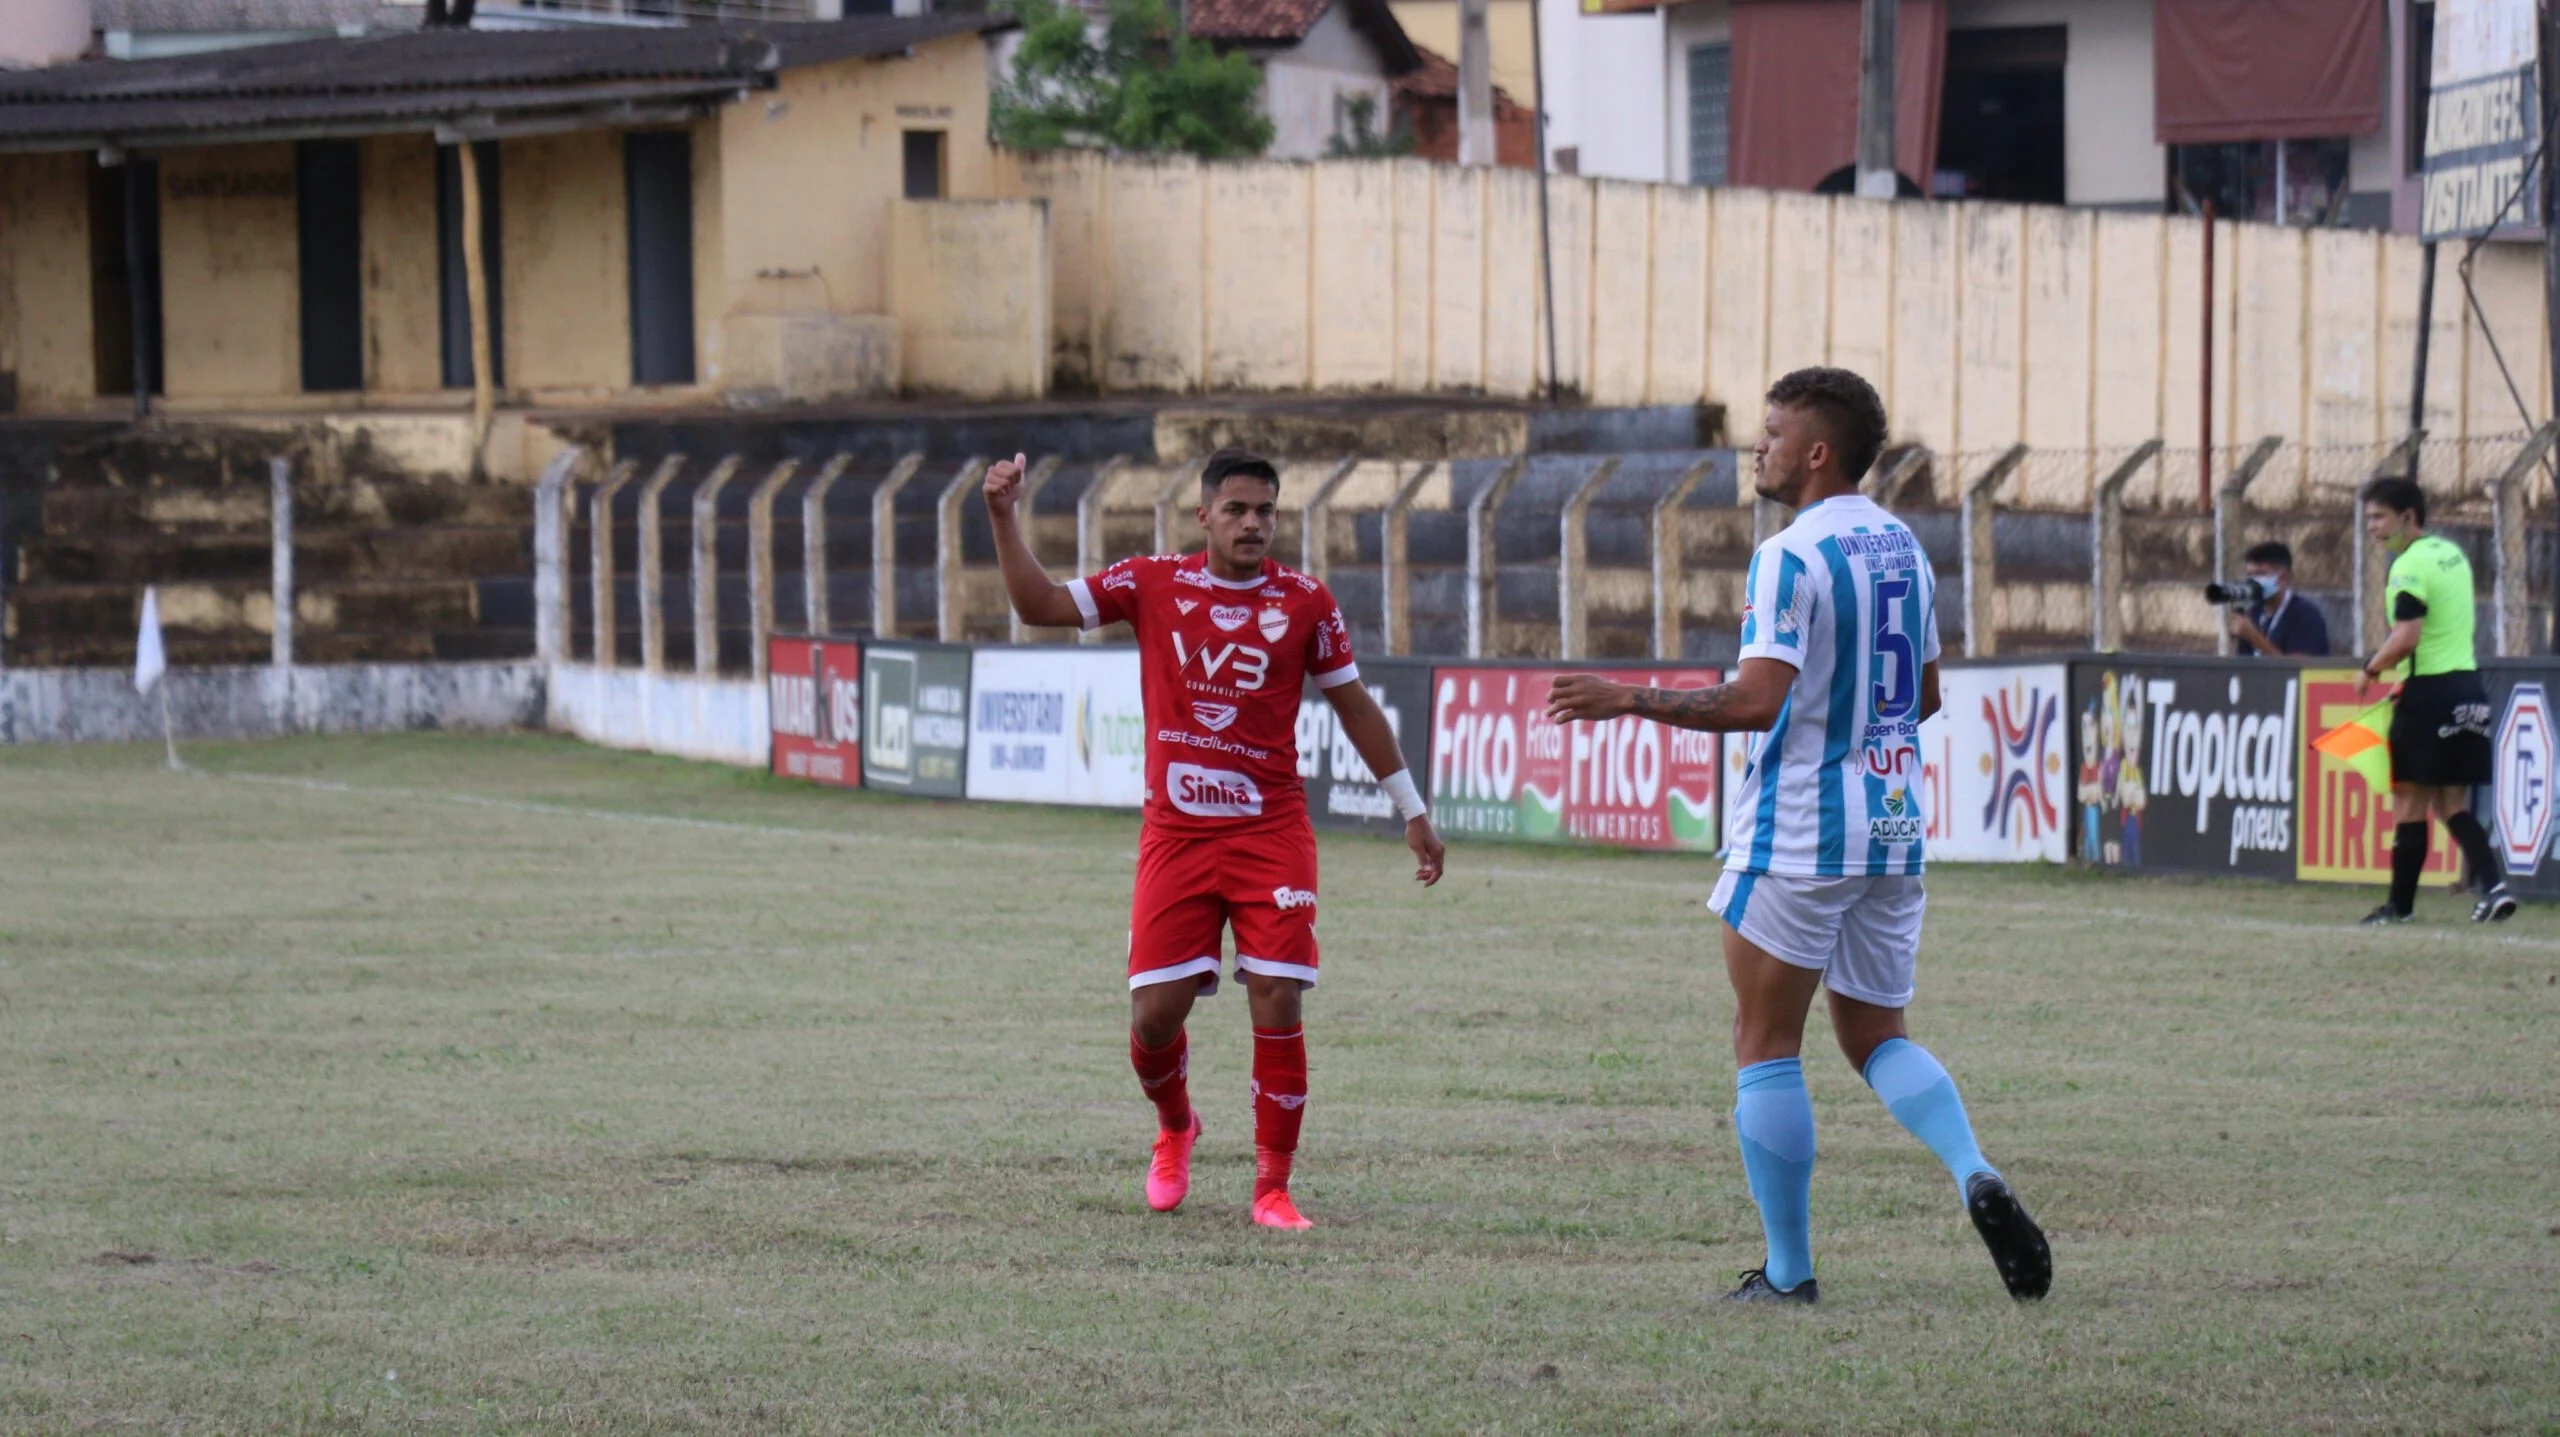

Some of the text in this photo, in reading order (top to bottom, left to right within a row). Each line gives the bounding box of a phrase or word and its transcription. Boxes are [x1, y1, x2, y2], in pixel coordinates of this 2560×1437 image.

[1211, 606, 1248, 623] Garlic
[1873, 578, 1915, 719] 5
[1186, 679, 1241, 698] COMPANIES
[1896, 721, 1919, 736] Bo
[1157, 729, 1269, 760] estadium.bet
[2147, 675, 2298, 834] Tropical
[1179, 774, 1250, 806] Sinhá
[1430, 802, 1516, 835] ALIMENTOS
[1569, 811, 1661, 841] ALIMENTOS
[2229, 806, 2291, 866] pneus
